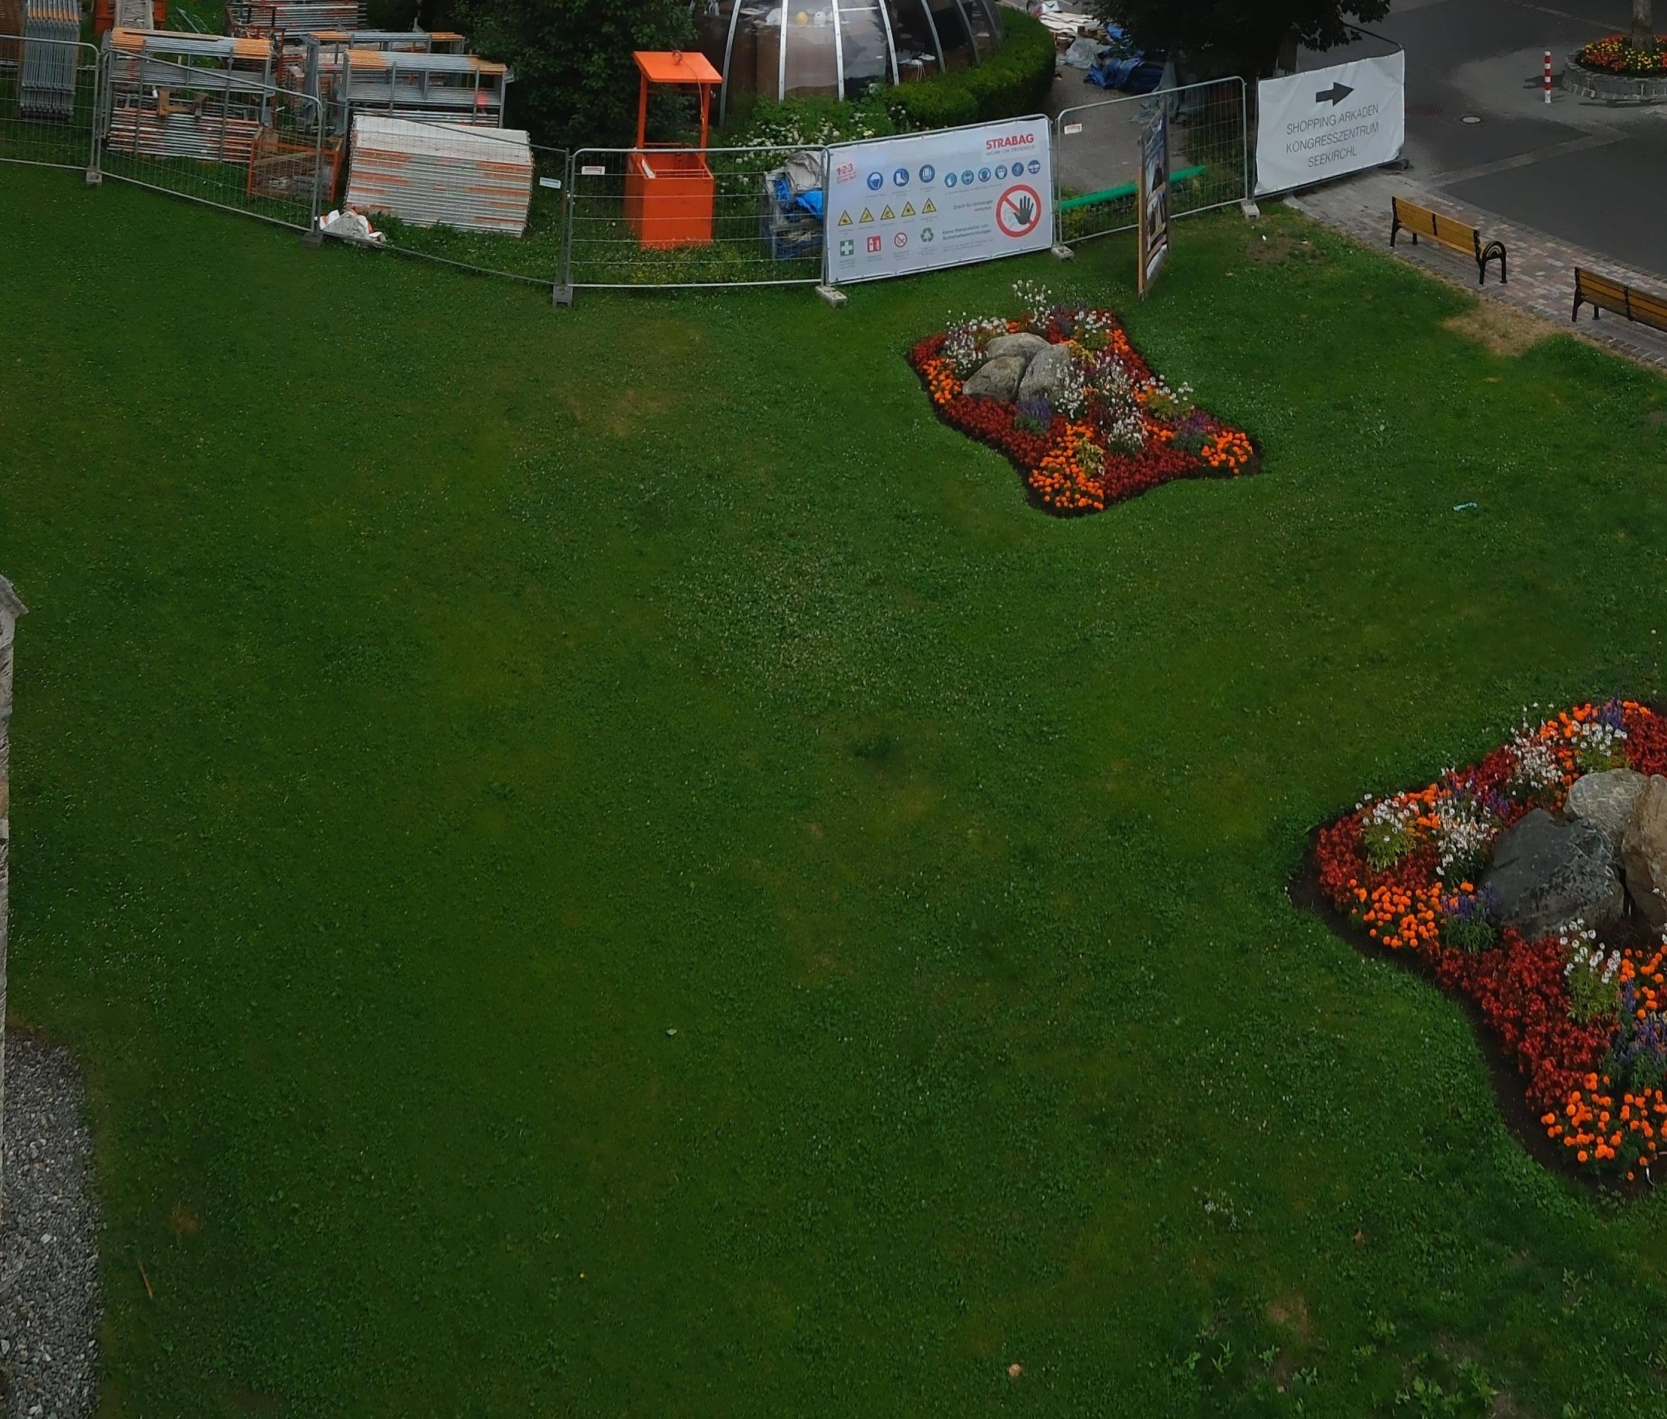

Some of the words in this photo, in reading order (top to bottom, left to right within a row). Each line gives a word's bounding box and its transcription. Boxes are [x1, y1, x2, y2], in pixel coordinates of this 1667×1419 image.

[1286, 115, 1337, 135] SHOPPING
[1338, 104, 1380, 124] ARKADEN
[986, 133, 1035, 150] STRABAG
[1286, 122, 1380, 154] KONGRESSZENTRUM
[1307, 147, 1358, 168] SEEKIRCHL
